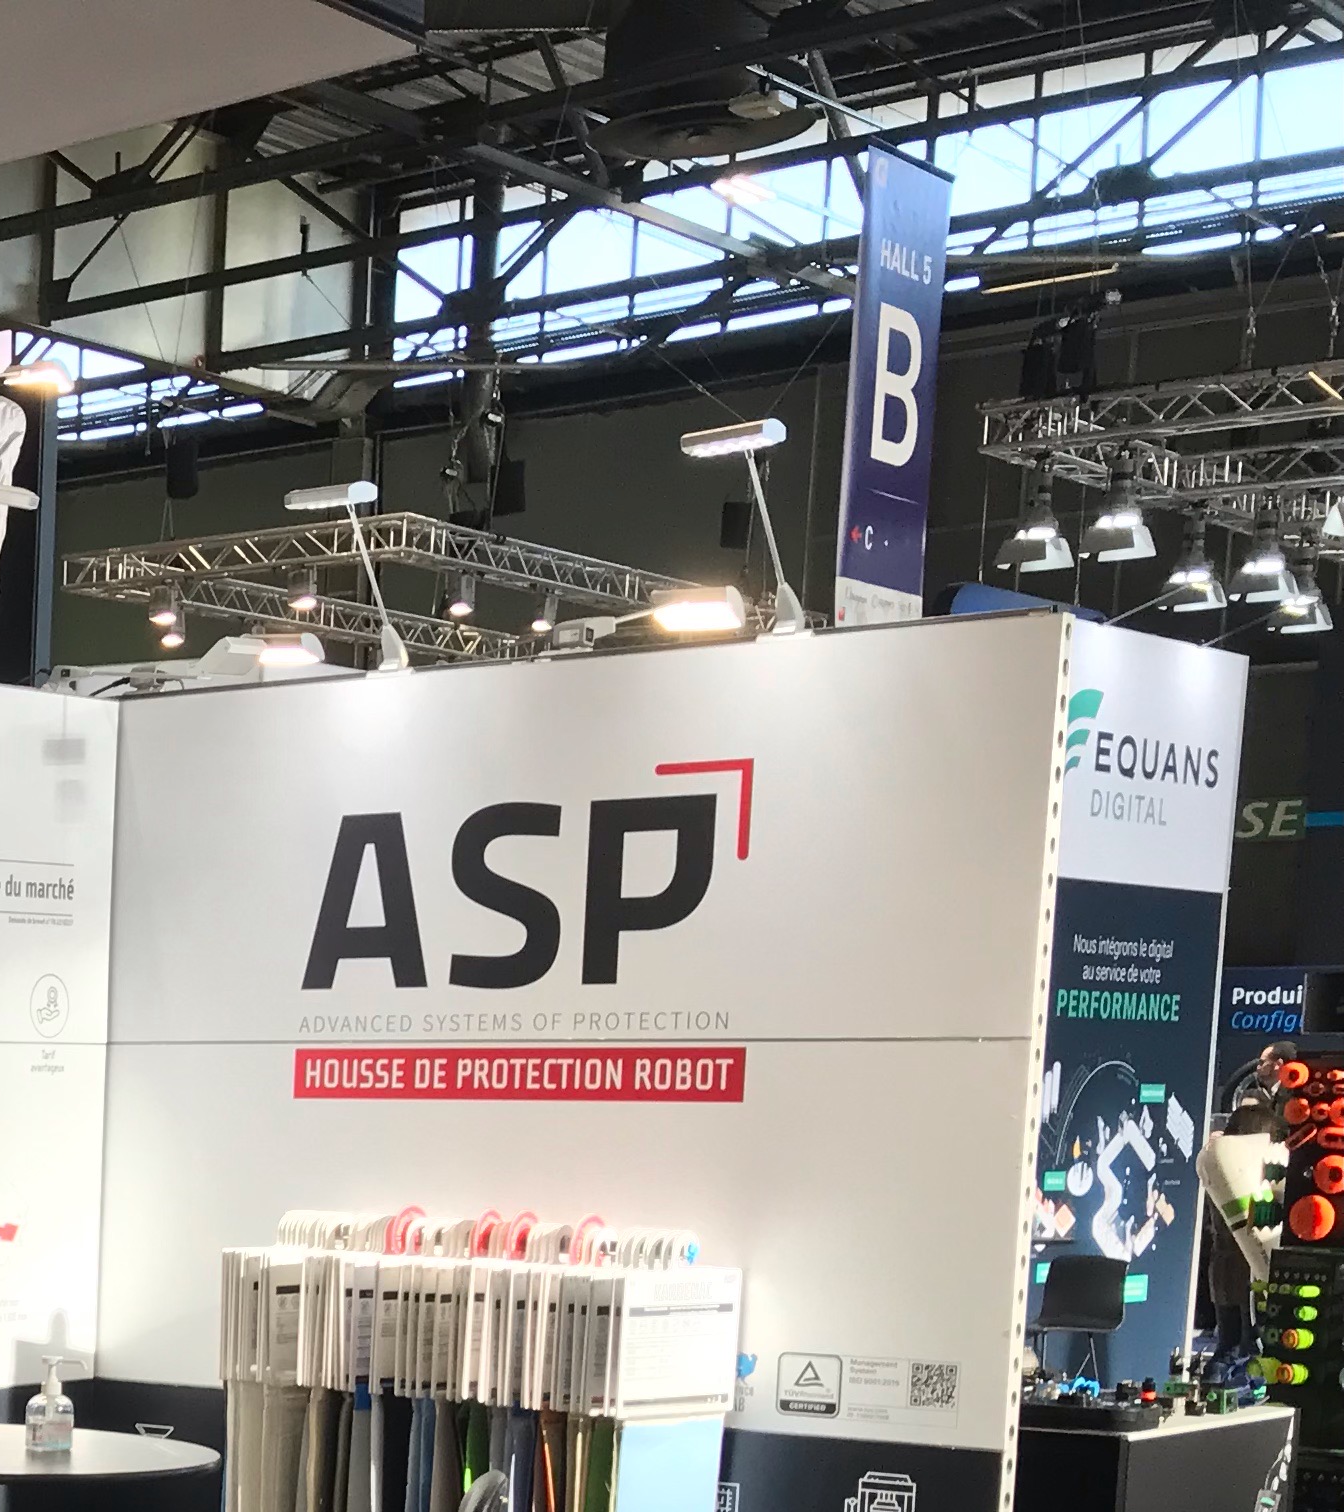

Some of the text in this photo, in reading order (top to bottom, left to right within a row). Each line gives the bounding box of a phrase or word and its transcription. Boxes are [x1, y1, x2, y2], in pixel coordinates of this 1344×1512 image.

[881, 238, 932, 285] HALL 5
[870, 302, 922, 467] B
[865, 525, 873, 550] C
[1094, 730, 1220, 790] EQUANS
[1090, 788, 1167, 827] DIGITAL
[5, 874, 22, 898] du
[26, 878, 75, 900] marché
[301, 793, 717, 990] ASP
[1073, 934, 1174, 962] Nous intégrons le digital
[1082, 963, 1161, 984] au service de votre
[299, 1010, 730, 1034] ADVANCED SYSTEMS OF PROTECTION
[1056, 988, 1181, 1022] PERFORMANCE
[304, 1058, 735, 1092] HOUSSE DE PROTECTION ROBOT
